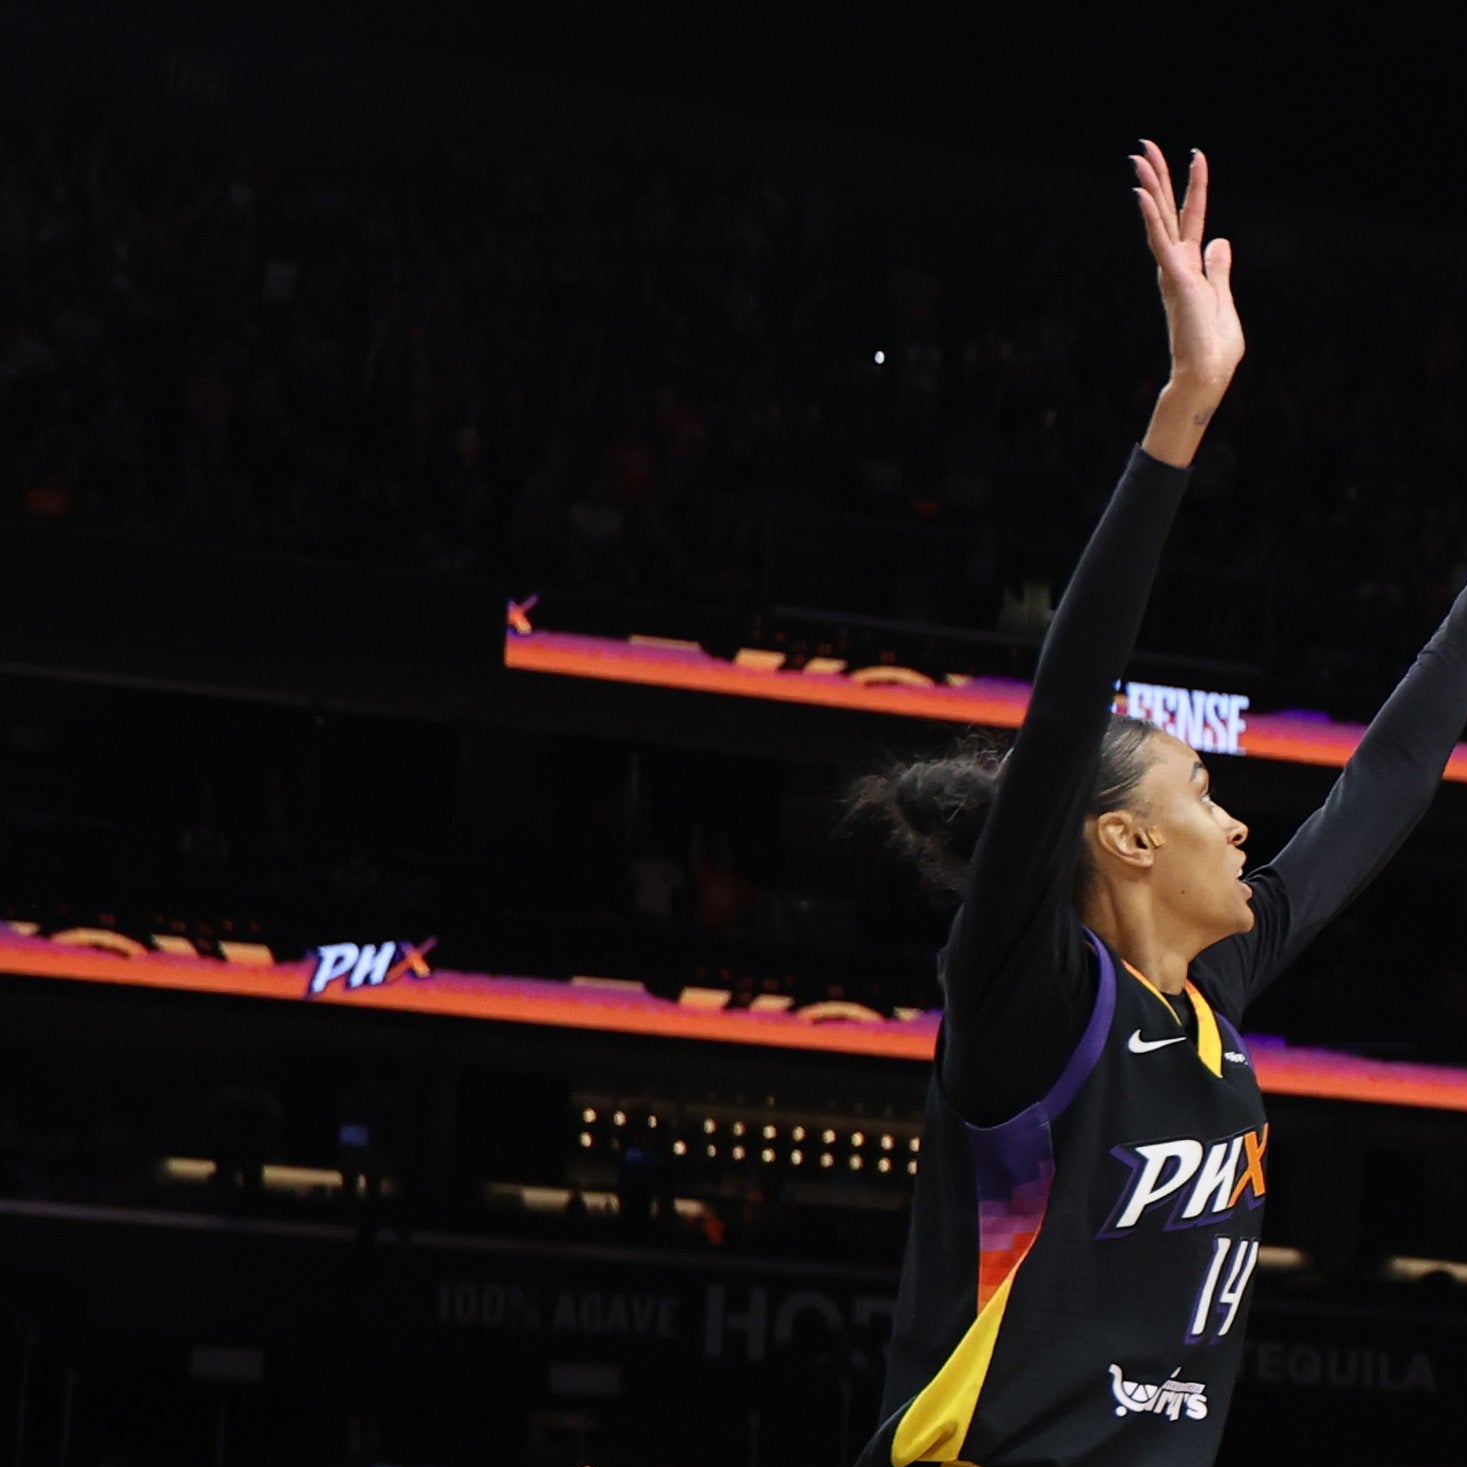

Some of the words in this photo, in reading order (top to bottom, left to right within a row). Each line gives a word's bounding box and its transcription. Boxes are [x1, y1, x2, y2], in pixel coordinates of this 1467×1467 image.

[309, 936, 439, 994] PHX
[1110, 1122, 1270, 1232] PHX
[437, 1277, 542, 1330] 100%
[553, 1287, 679, 1338] AGAVE
[1190, 1236, 1260, 1338] 14
